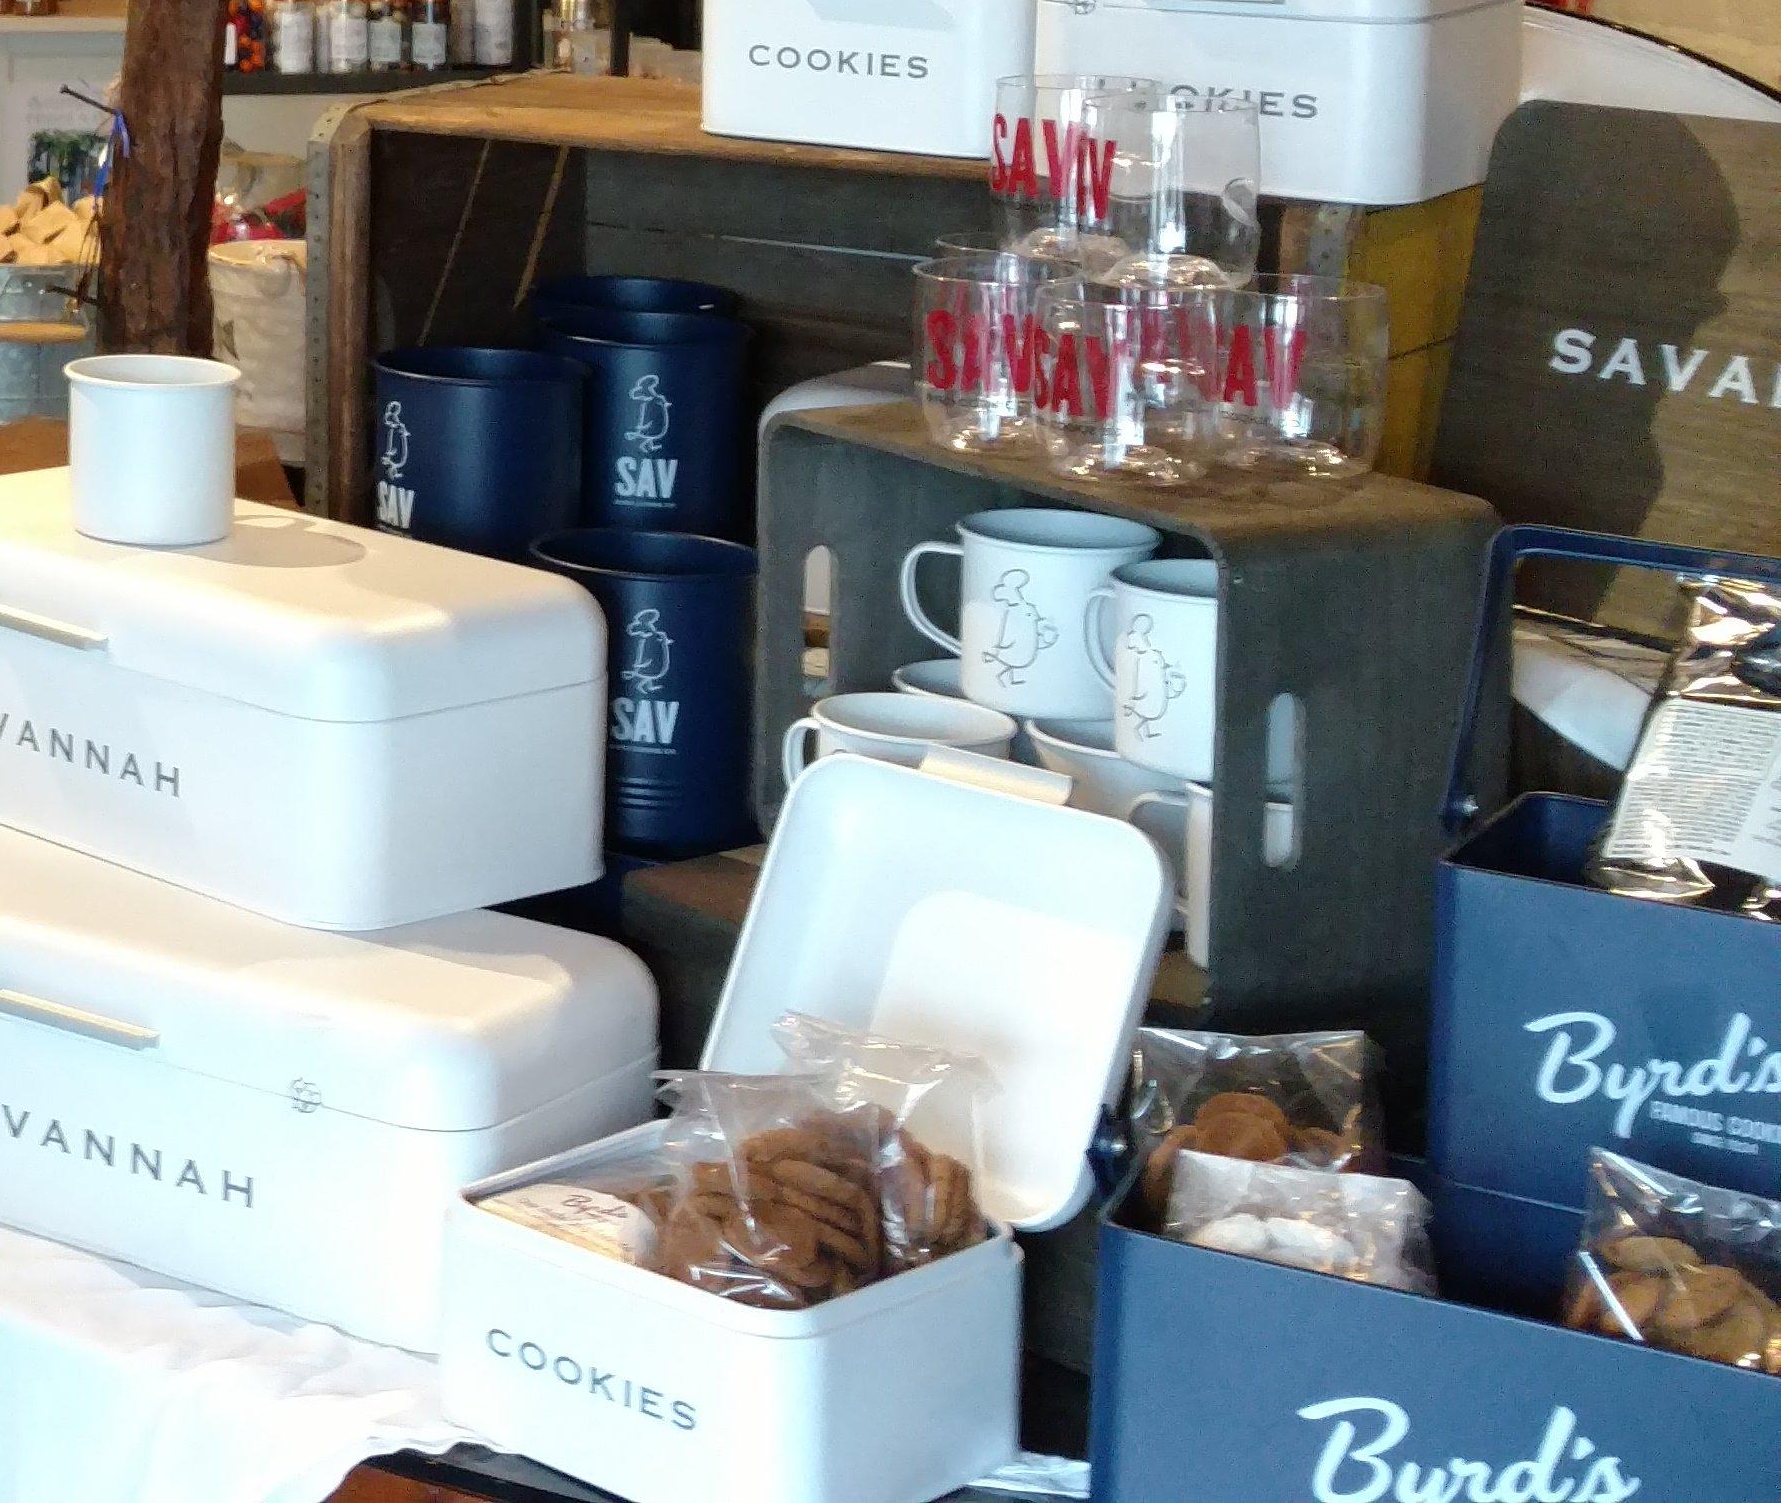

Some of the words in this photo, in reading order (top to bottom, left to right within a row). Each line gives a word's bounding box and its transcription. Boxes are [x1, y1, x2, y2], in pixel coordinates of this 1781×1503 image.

[747, 44, 930, 80] COOKIES
[614, 456, 679, 499] SAV
[378, 480, 416, 530] SAV
[611, 697, 680, 745] SAV
[485, 1328, 697, 1431] COOKIES
